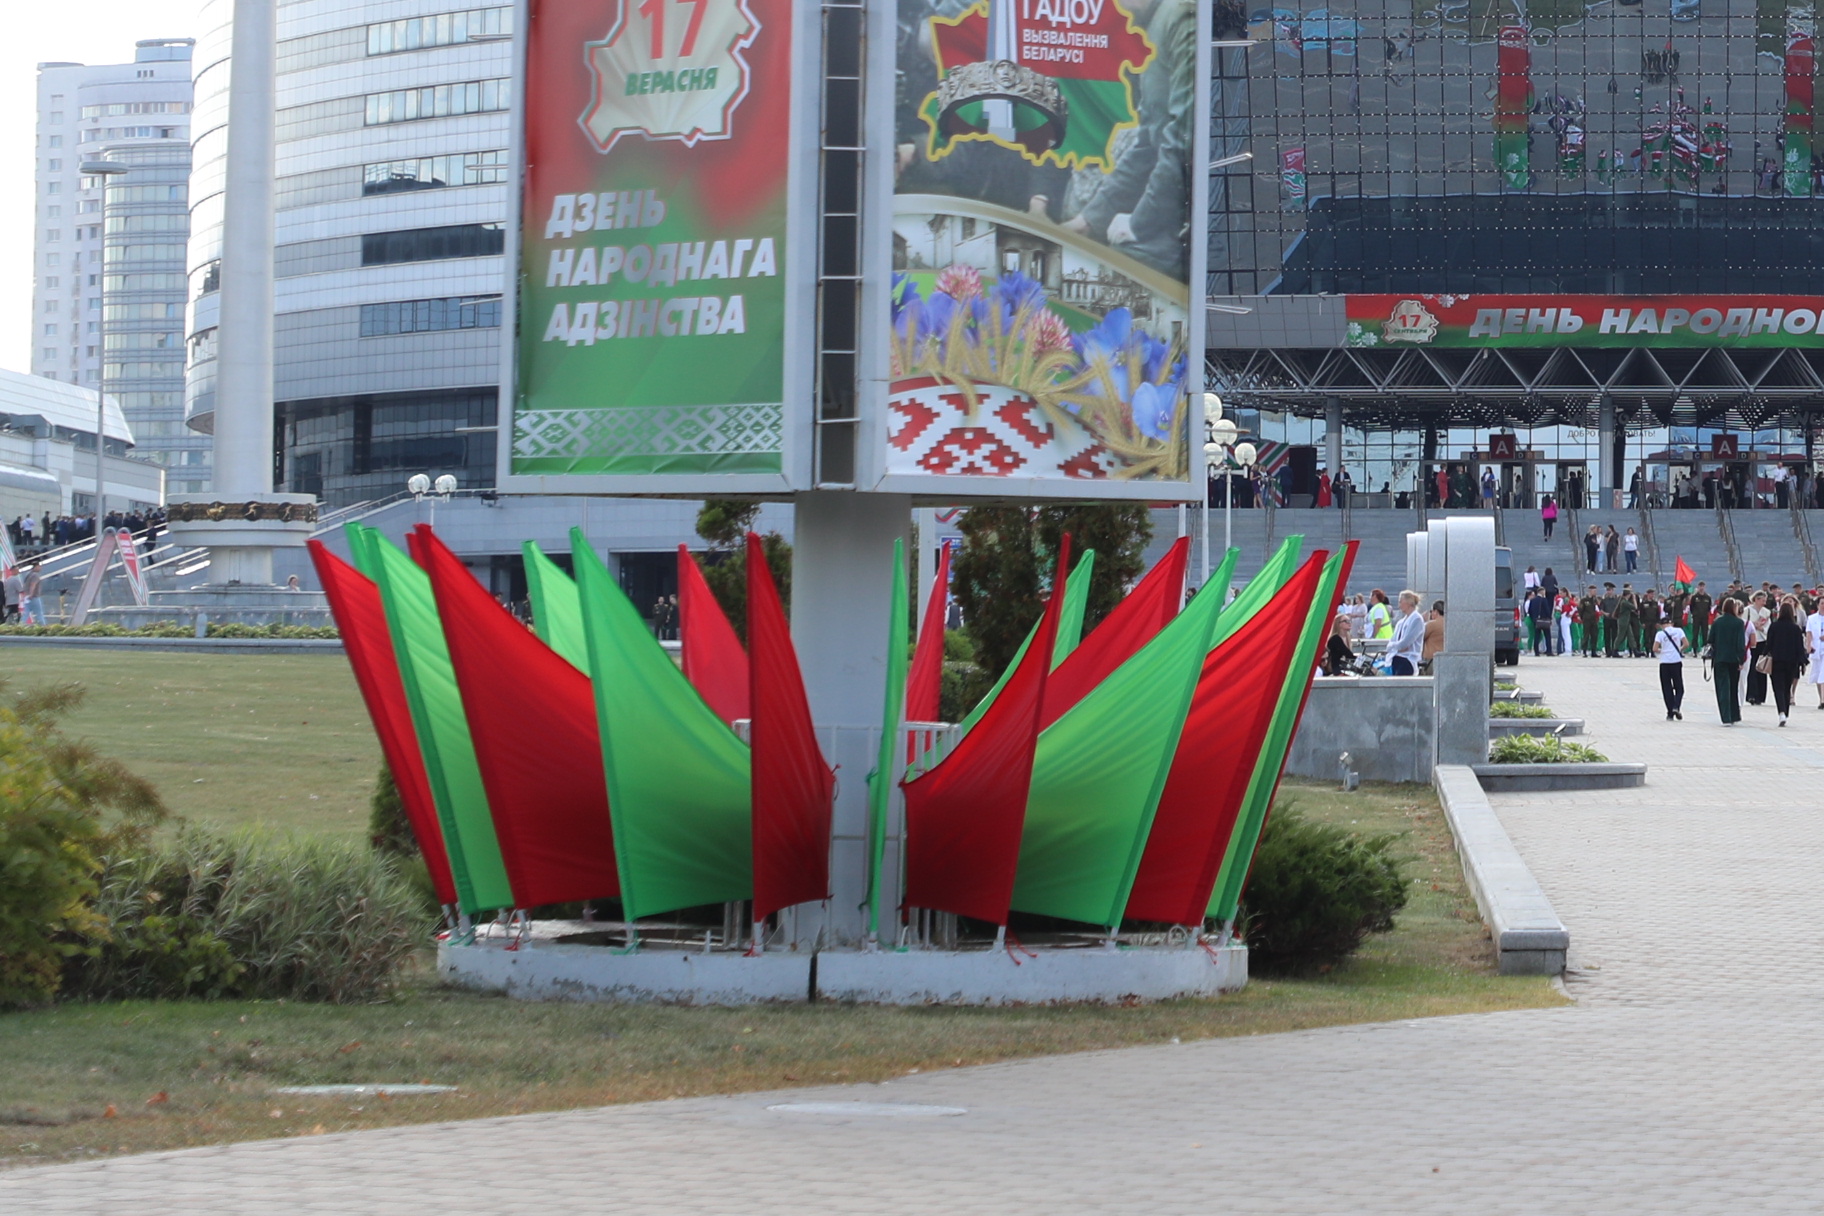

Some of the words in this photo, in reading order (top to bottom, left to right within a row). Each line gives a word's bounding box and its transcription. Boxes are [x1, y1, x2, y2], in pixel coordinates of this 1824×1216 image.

[1022, 28, 1109, 49] ВЫЗВАЛЕННЯ
[1022, 45, 1084, 64] БЕЛАРУСІ
[624, 65, 719, 97] ВЕРАСНЯ
[544, 189, 667, 240] ДЗЕНЬ
[545, 237, 776, 287] НАРОДНАГА
[542, 295, 746, 347] АДЗІНСТВА
[1398, 314, 1422, 328] 17
[1468, 307, 1584, 338] ДЕНЬ
[1568, 429, 1596, 438] ДОБРО
[1495, 440, 1509, 455] A
[1718, 440, 1732, 455] A
